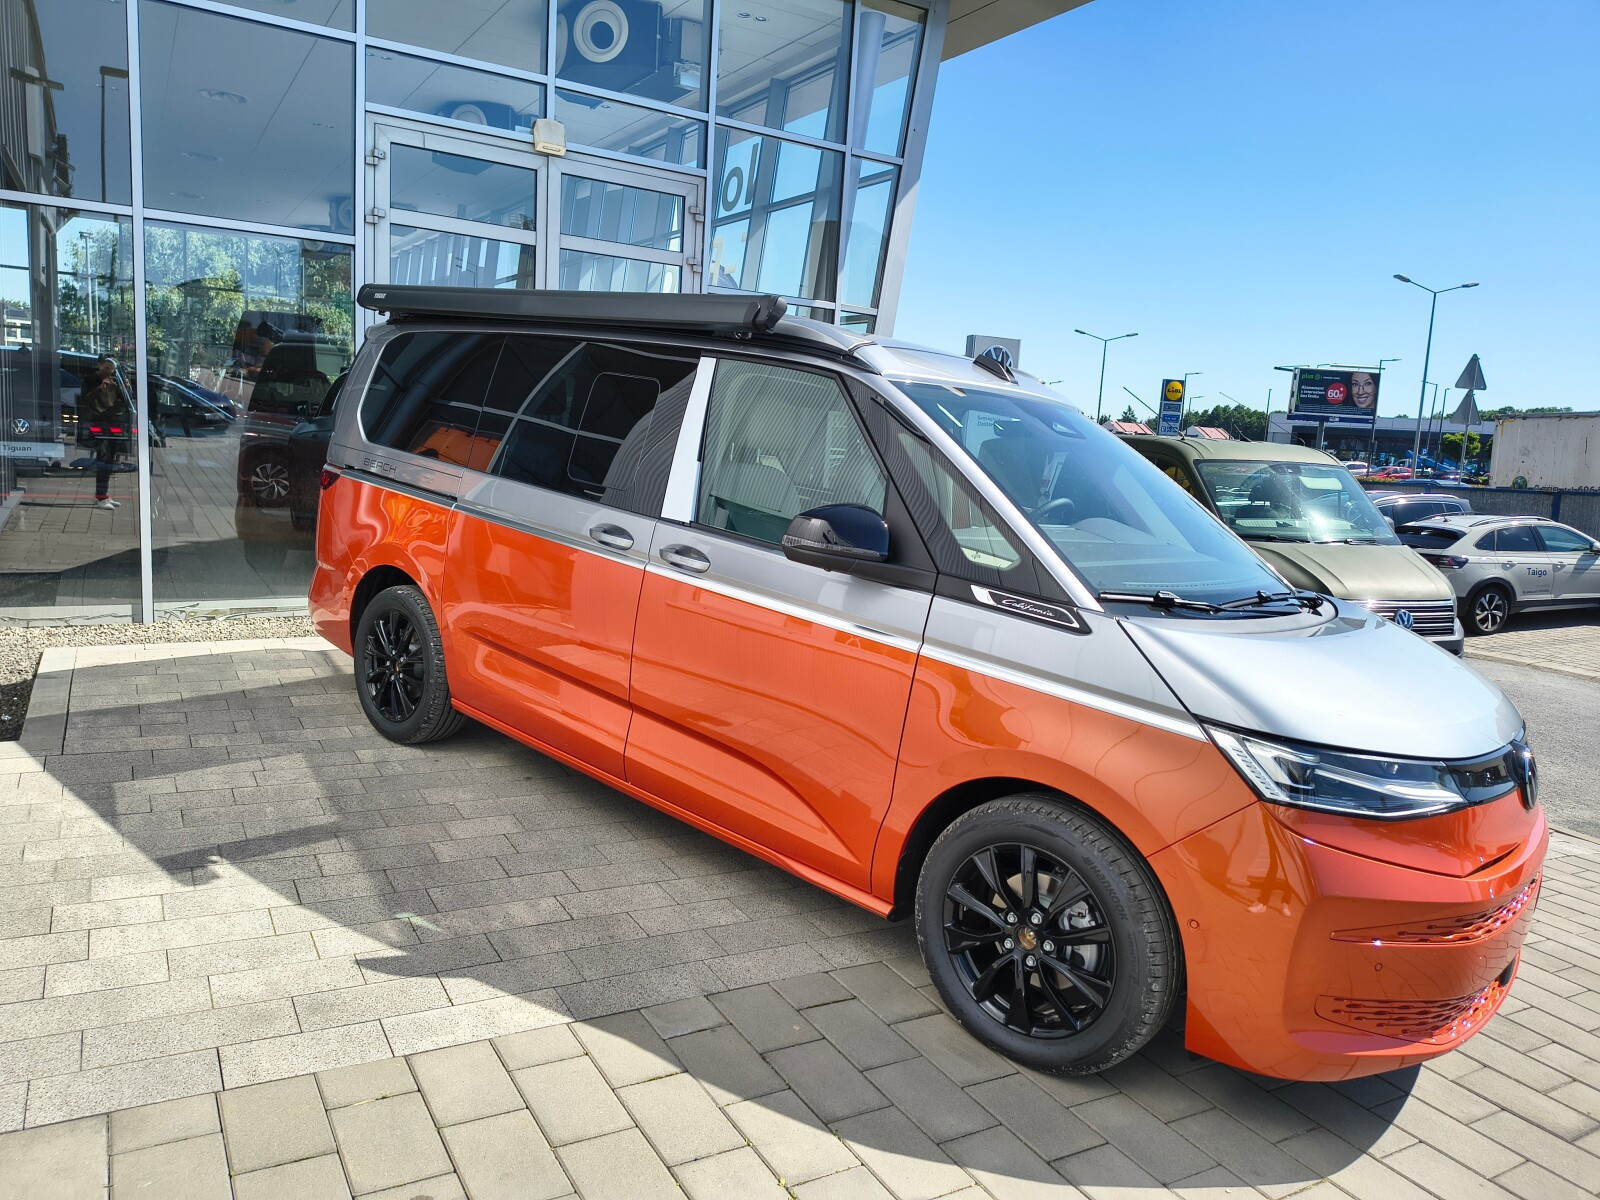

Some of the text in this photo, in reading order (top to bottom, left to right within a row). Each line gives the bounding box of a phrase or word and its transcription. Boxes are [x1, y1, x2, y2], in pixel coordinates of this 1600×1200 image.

[2, 444, 32, 452] Tiguan
[363, 457, 397, 474] BEACH
[1526, 567, 1548, 578] Taigo
[1001, 599, 1055, 617] California
